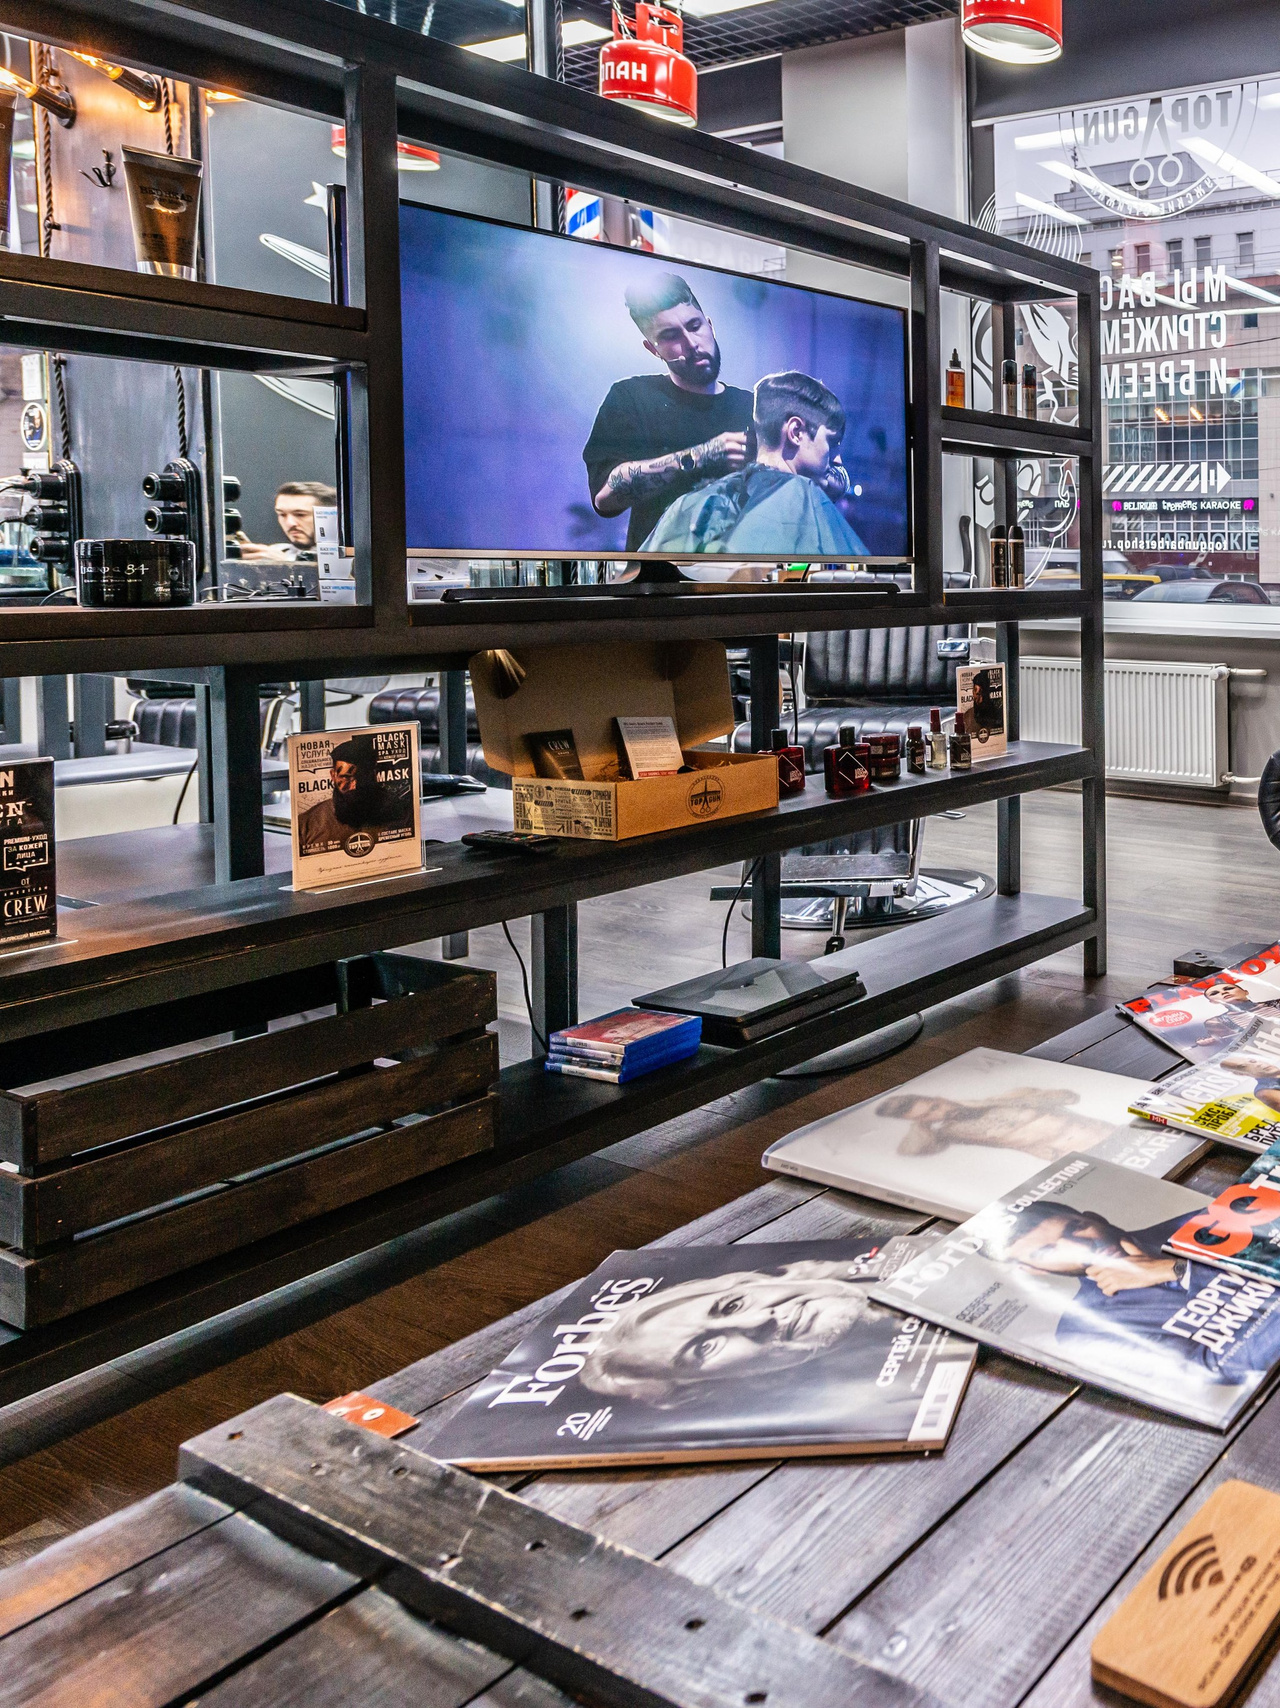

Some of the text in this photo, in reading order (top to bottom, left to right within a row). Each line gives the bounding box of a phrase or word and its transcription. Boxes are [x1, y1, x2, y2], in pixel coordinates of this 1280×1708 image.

[602, 62, 648, 82] ПАН
[1200, 501, 1242, 509] KARAOKE
[1145, 532, 1259, 550] KARAOKE
[125, 563, 149, 575] 84
[300, 740, 330, 751] НОВАЯ
[377, 732, 405, 743] BLACK
[378, 740, 405, 750] MASK
[301, 749, 331, 759] УСЛУГА
[0, 771, 14, 788] N
[377, 768, 409, 782] MASK
[298, 778, 333, 793] BLACK
[8, 841, 43, 853] ЗА КОЖЕЙ
[16, 851, 36, 860] ЛИЦА
[21, 878, 30, 886] ОТ
[4, 894, 47, 917] CREW
[1194, 1107, 1221, 1127] СЕКС
[1243, 1118, 1276, 1142] БРЕД
[1123, 1127, 1186, 1170] BARE
[887, 1159, 1090, 1301] Forbs COLLECTION
[488, 1277, 655, 1409] Forbes
[876, 1331, 911, 1389] СЕРГЕЙ
[556, 1412, 592, 1438] 20
